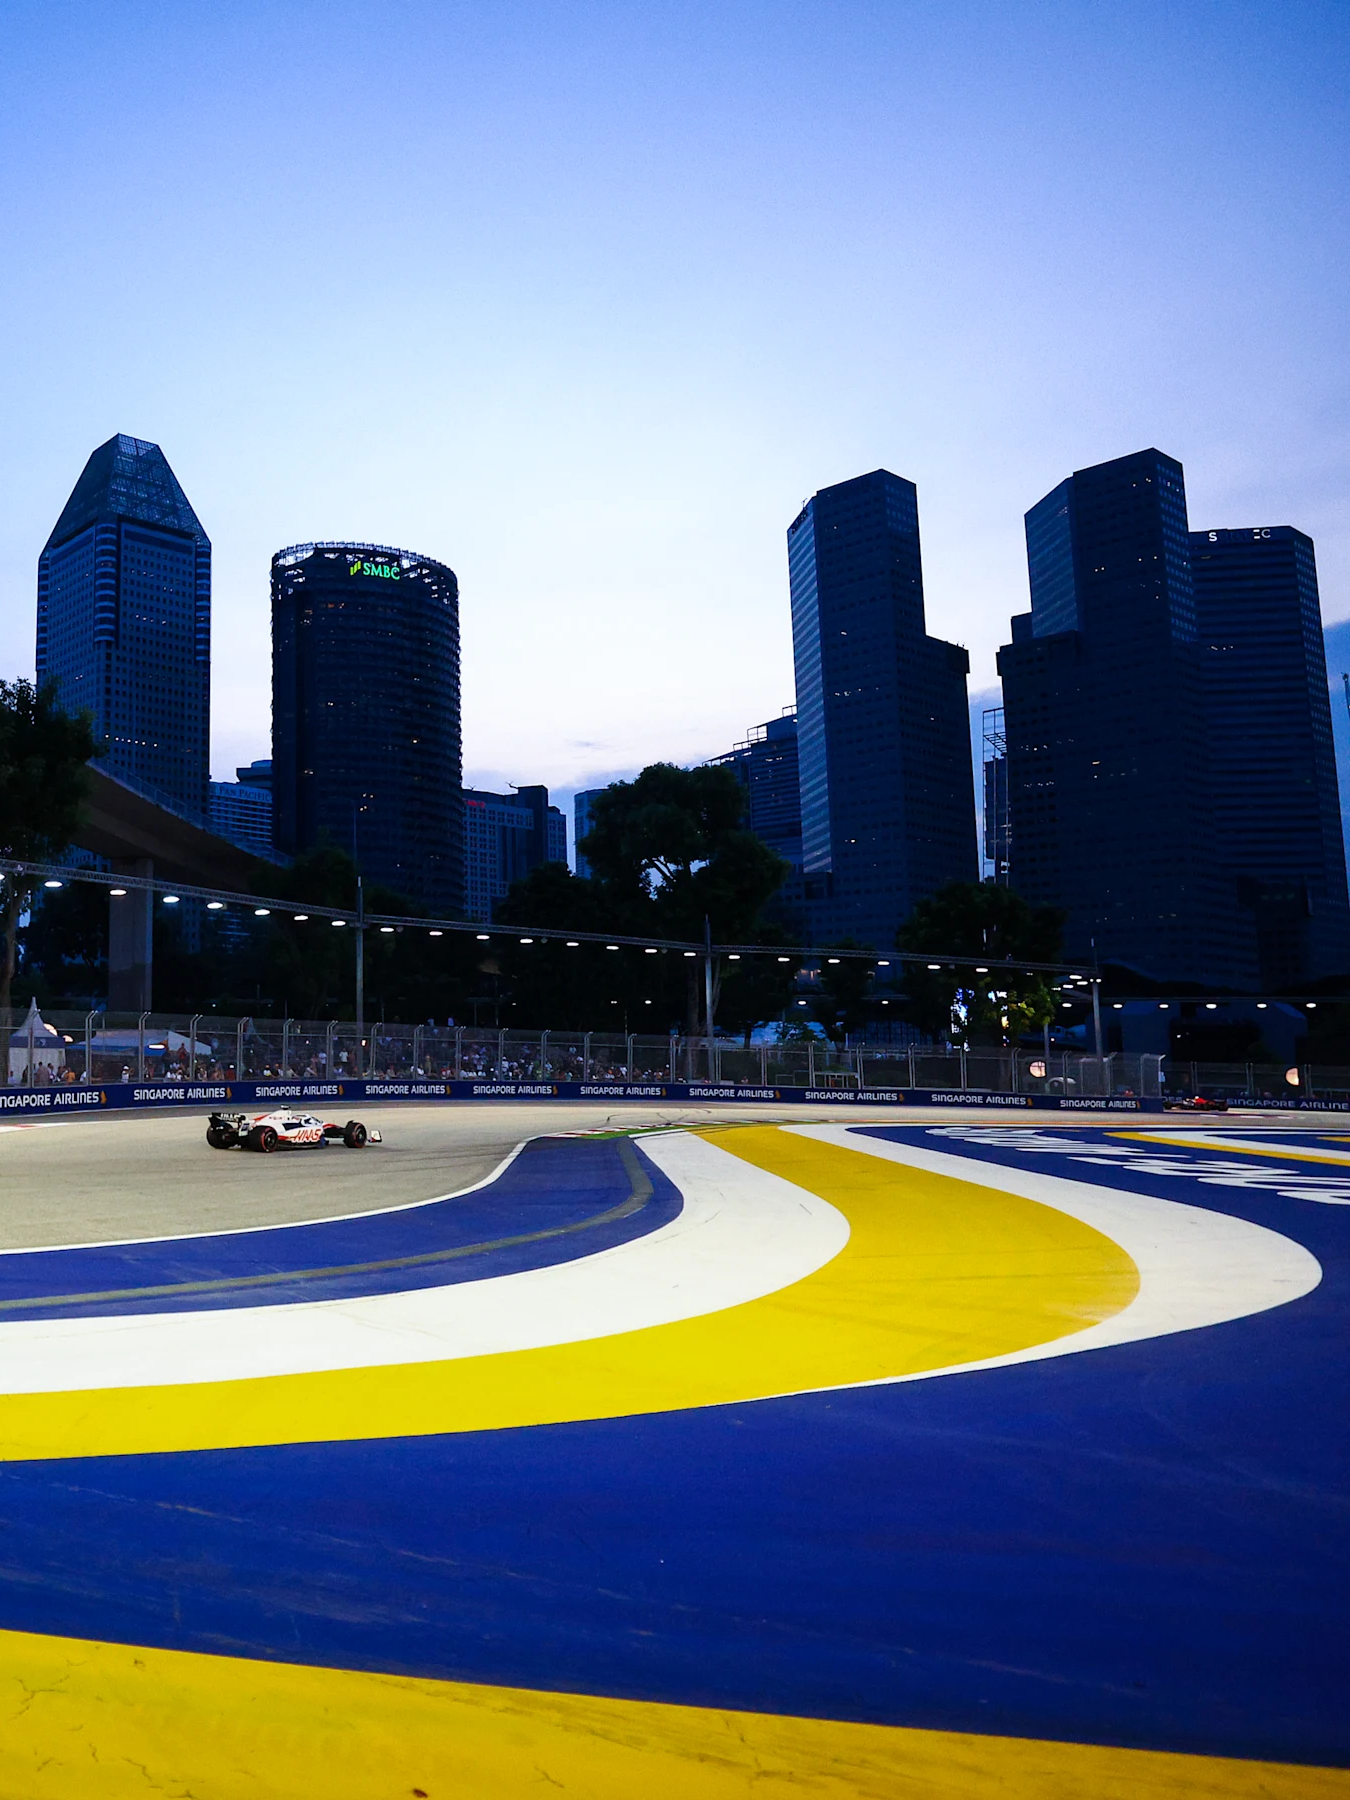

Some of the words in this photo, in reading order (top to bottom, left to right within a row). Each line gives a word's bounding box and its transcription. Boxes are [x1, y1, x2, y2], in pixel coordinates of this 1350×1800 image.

[363, 562, 401, 580] SMBC
[133, 1088, 184, 1101] SINGAPORE
[186, 1087, 226, 1099] AIRLINES
[255, 1085, 301, 1097] SINGAPORE
[302, 1084, 338, 1096] AIRLINES
[365, 1084, 408, 1095] SINGAPORE
[410, 1084, 446, 1095] AIRLINES
[472, 1085, 515, 1095] SINGAPORE
[517, 1085, 553, 1095] AIRLINES
[579, 1085, 623, 1096] SINGAPORE
[625, 1086, 662, 1096] AIRLINES
[689, 1087, 735, 1098] SINGAPORE
[736, 1089, 775, 1099] AIRLINES
[53, 1091, 100, 1106] AIRLINES
[804, 1091, 854, 1101] SINGAPORE
[856, 1092, 898, 1101] AIRLINES
[931, 1093, 983, 1105] SINGAPORE
[984, 1095, 1028, 1106] AIRLINES
[1059, 1099, 1106, 1110] SINGAPORE
[1107, 1100, 1137, 1110] AIRLINES
